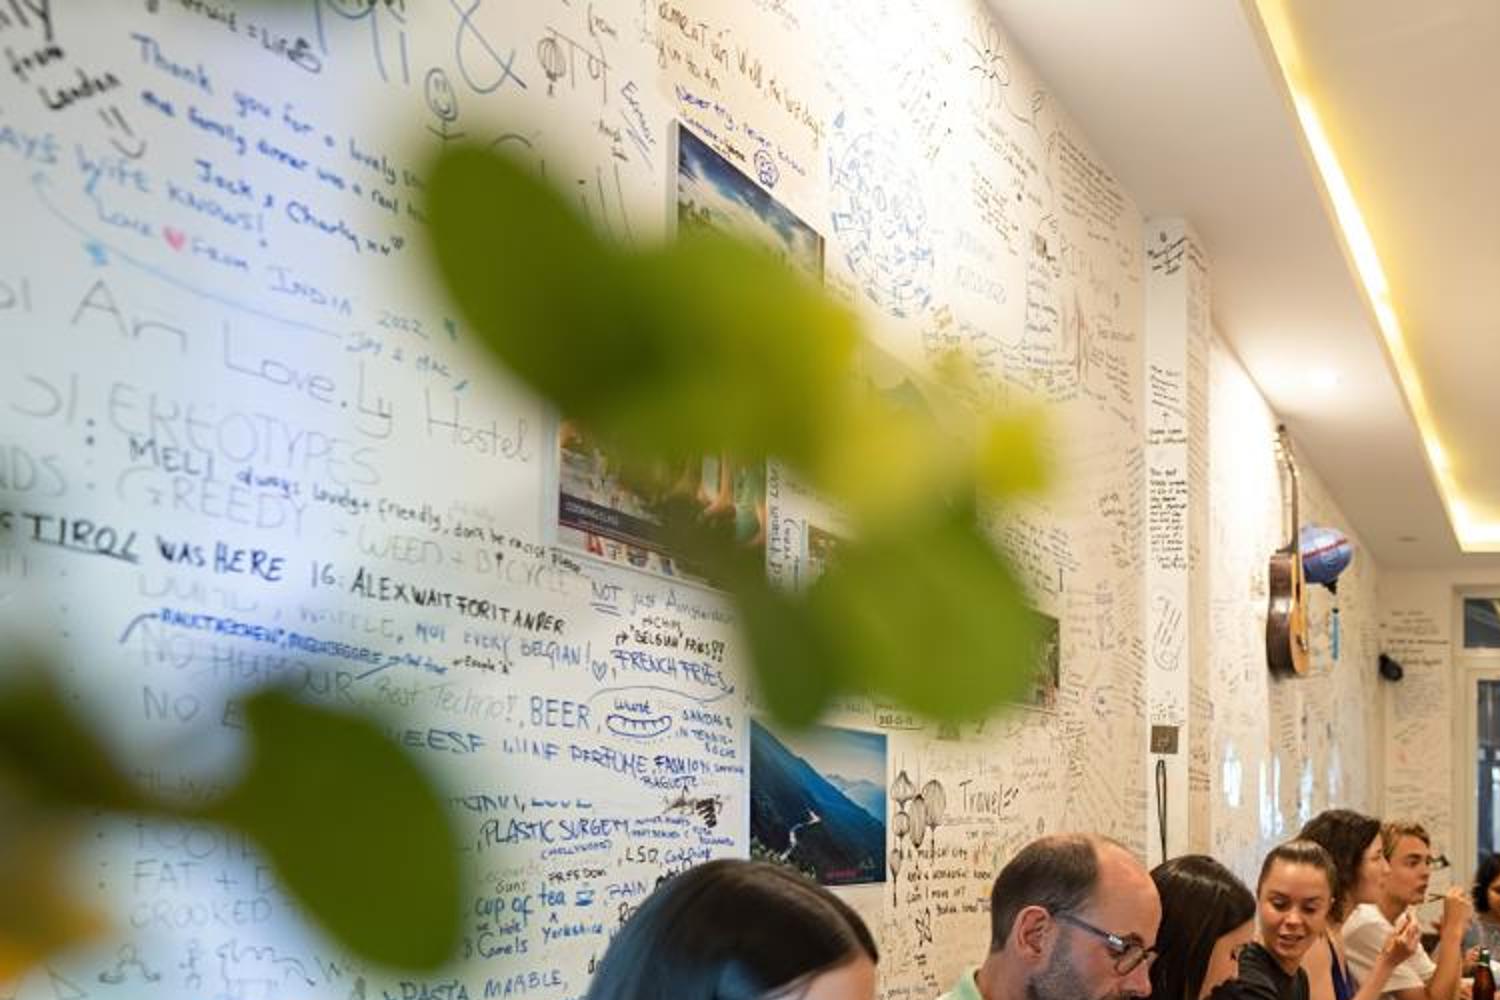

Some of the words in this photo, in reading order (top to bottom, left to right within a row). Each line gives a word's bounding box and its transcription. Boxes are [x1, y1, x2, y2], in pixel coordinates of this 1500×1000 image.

[213, 540, 286, 583] HERE
[609, 648, 678, 675] FRENCH
[536, 881, 567, 908] tea
